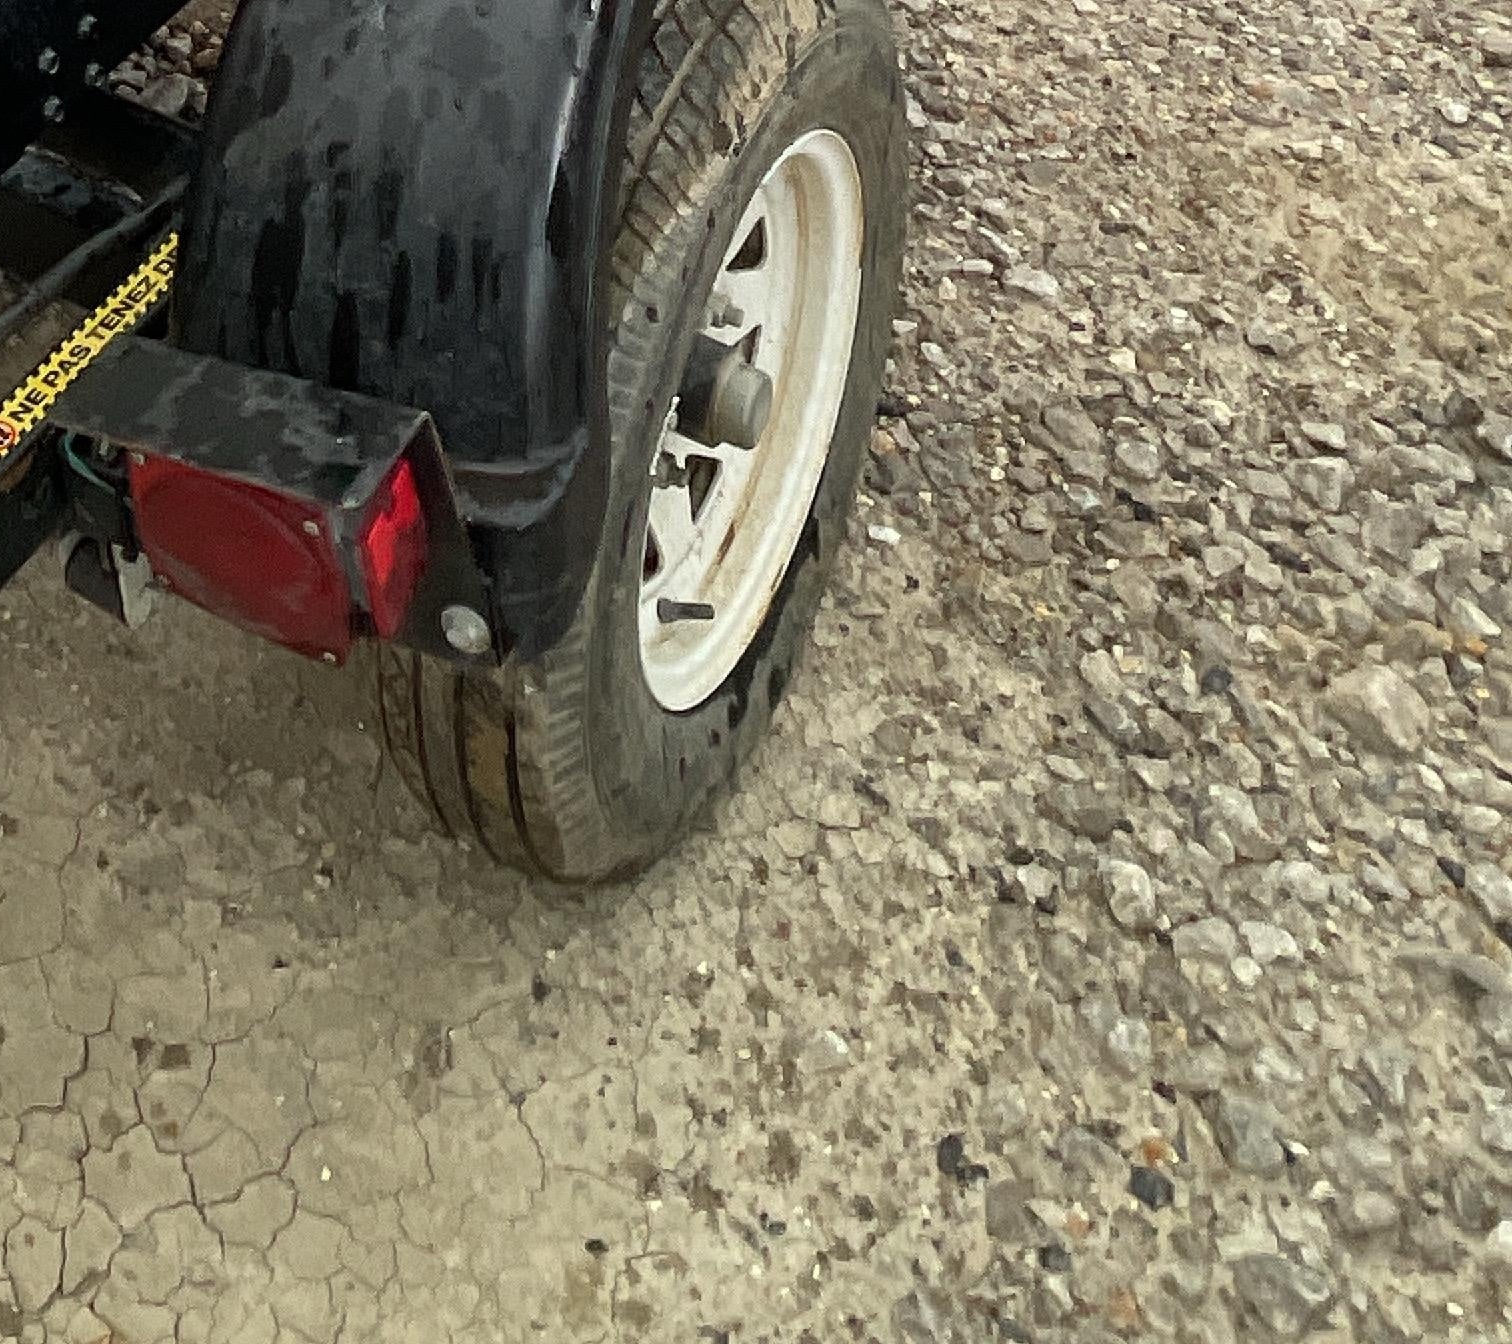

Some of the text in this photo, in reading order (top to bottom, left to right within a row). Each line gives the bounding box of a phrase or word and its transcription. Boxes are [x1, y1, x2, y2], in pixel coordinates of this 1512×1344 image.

[6, 387, 49, 423] NE
[41, 343, 93, 390] PAS
[84, 274, 160, 340] TENEZ
